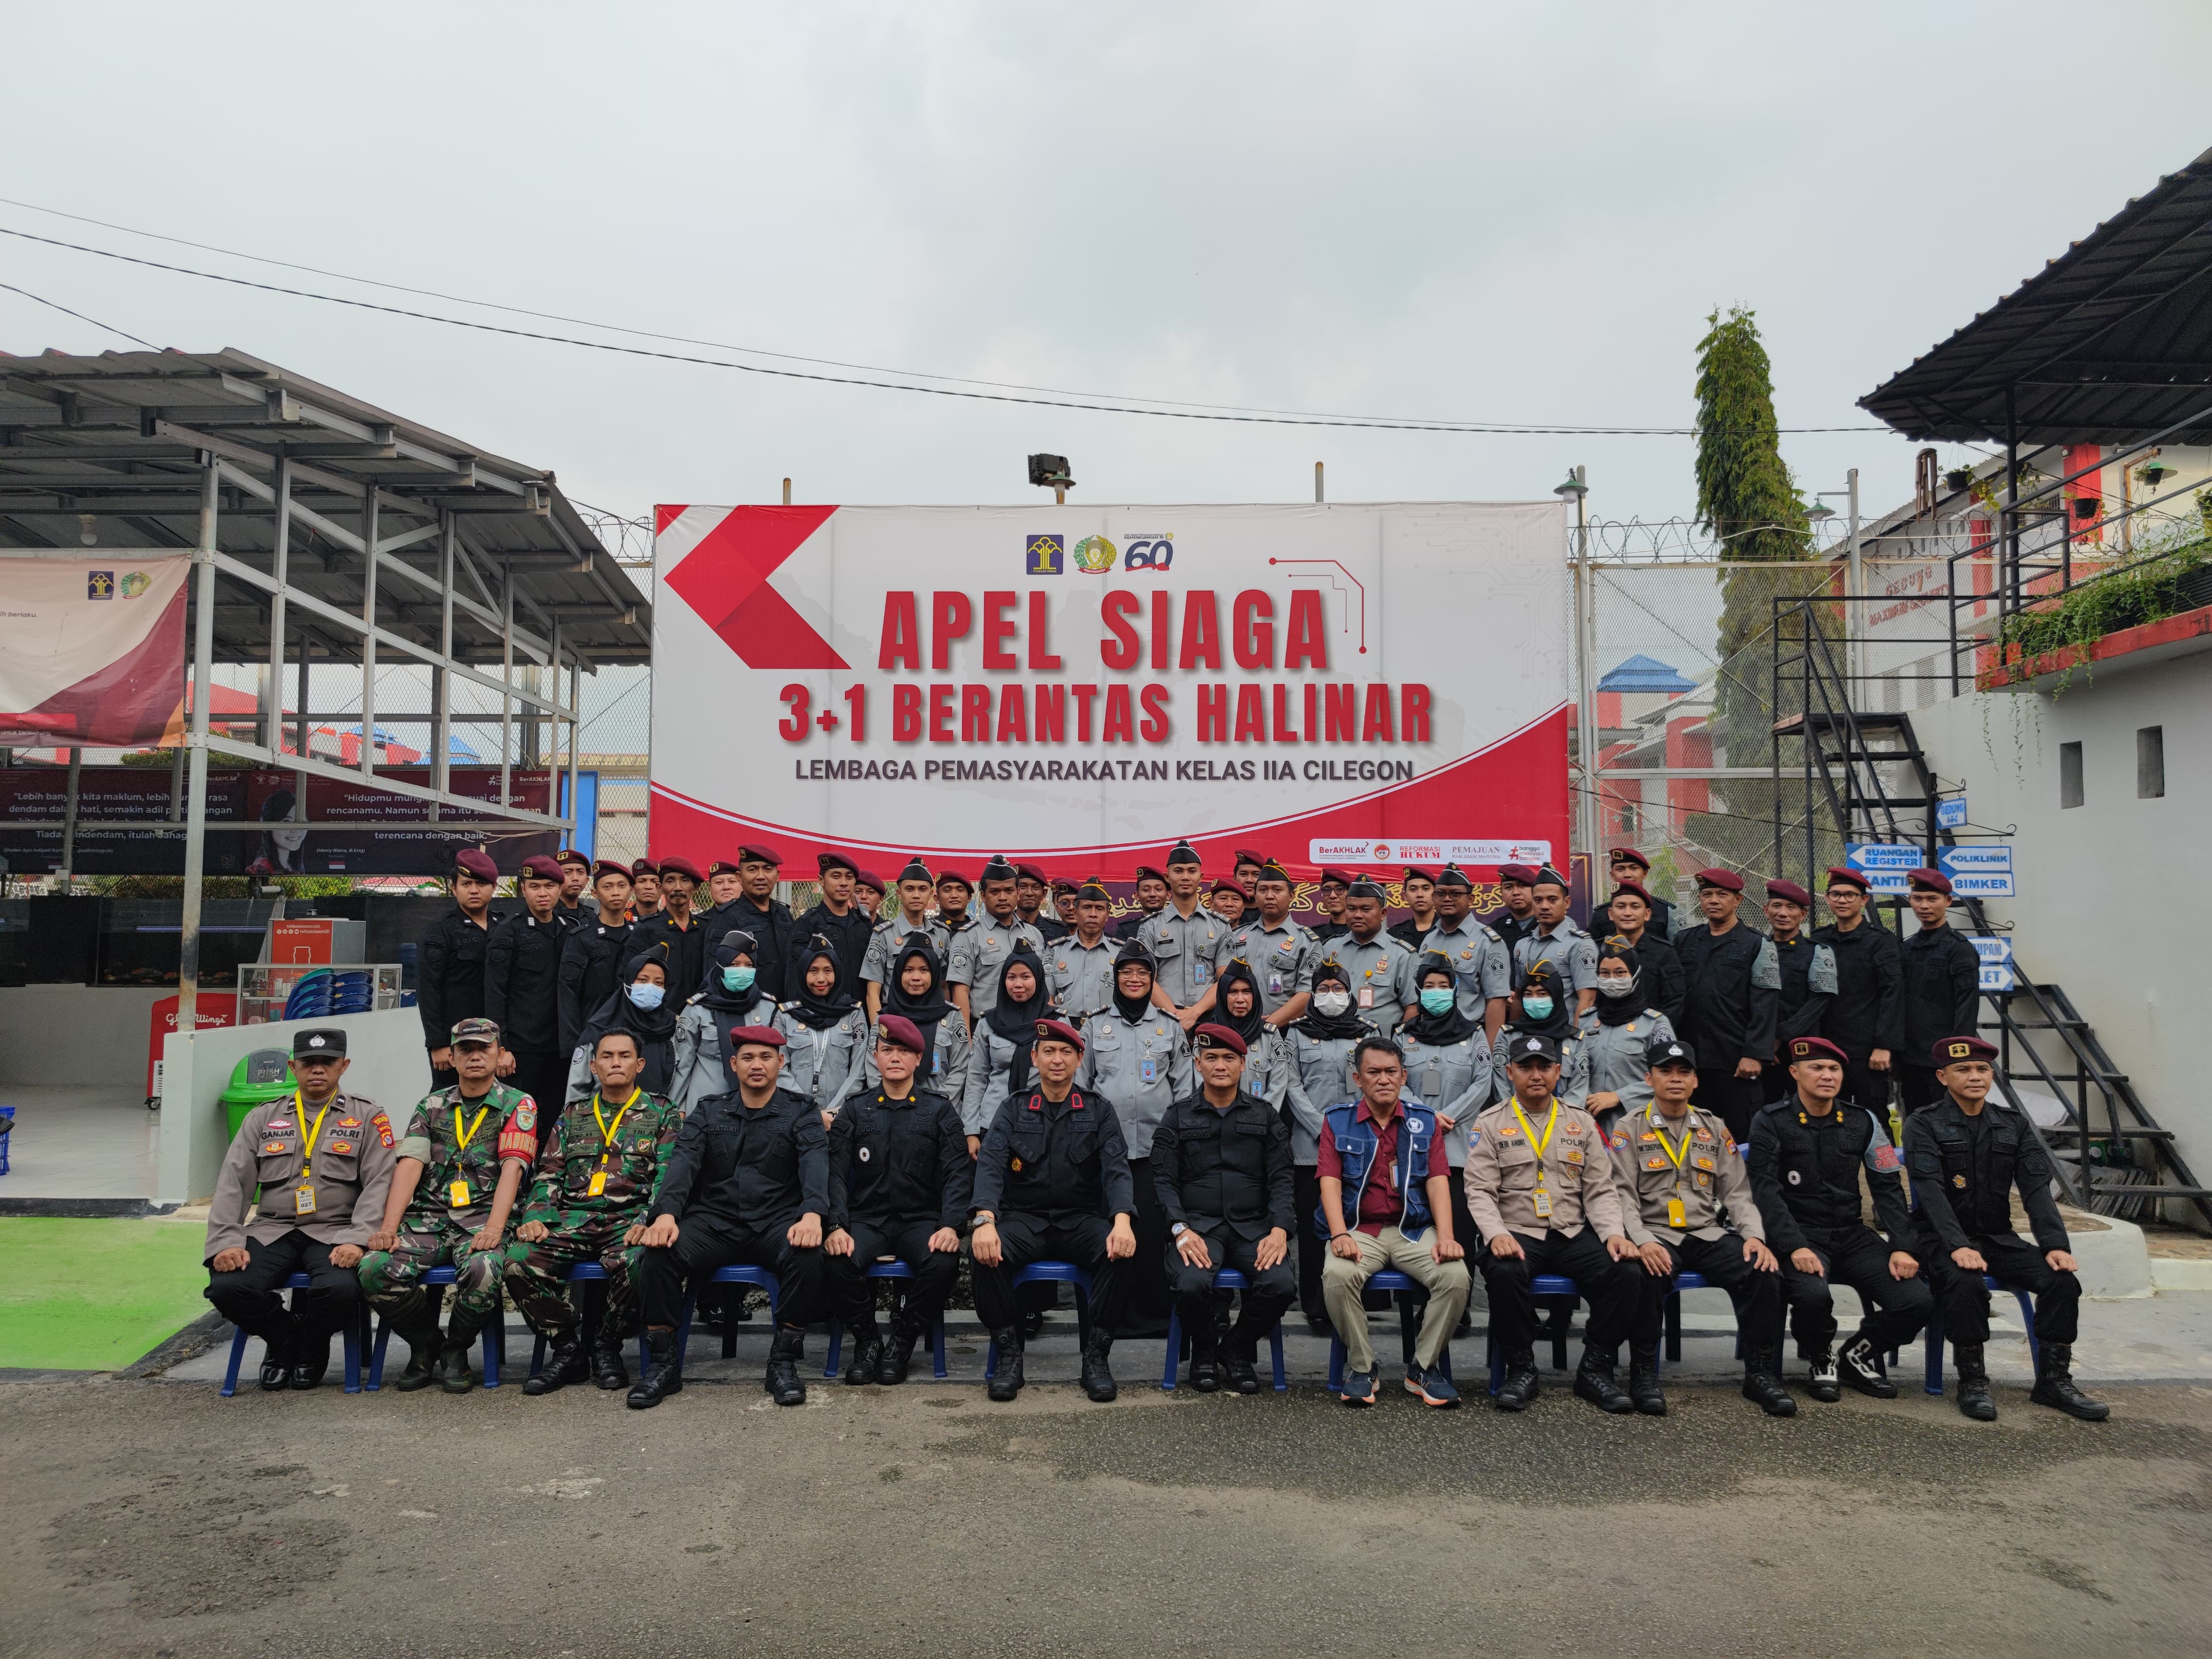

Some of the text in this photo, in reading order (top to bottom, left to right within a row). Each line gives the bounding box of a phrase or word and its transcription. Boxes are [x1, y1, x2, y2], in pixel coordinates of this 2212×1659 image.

[1125, 540, 1173, 569] 60
[878, 589, 1327, 670] APEL SIAGA
[779, 683, 1430, 742] 3+1 BERANTAS HALINAR
[796, 759, 1415, 782] LEMBAGA PEMASYARAKATAN KELAS IIA CILEGON
[104, 793, 144, 802] maklum,
[81, 805, 102, 814] hati,
[1941, 803, 1963, 816] GEDUNG
[128, 831, 155, 839] itulah
[425, 833, 462, 841] dengan
[1865, 857, 1918, 866] REGISTER
[1865, 876, 1911, 886] ANTI
[1955, 879, 2008, 889] BIMKER
[257, 1068, 280, 1076] PUSH
[330, 1129, 360, 1139] POLRI
[709, 1125, 737, 1133] JATARI
[1181, 1129, 1209, 1138] AGUNG
[261, 1129, 296, 1140] GANJAR
[1560, 1137, 1586, 1148] POLRI
